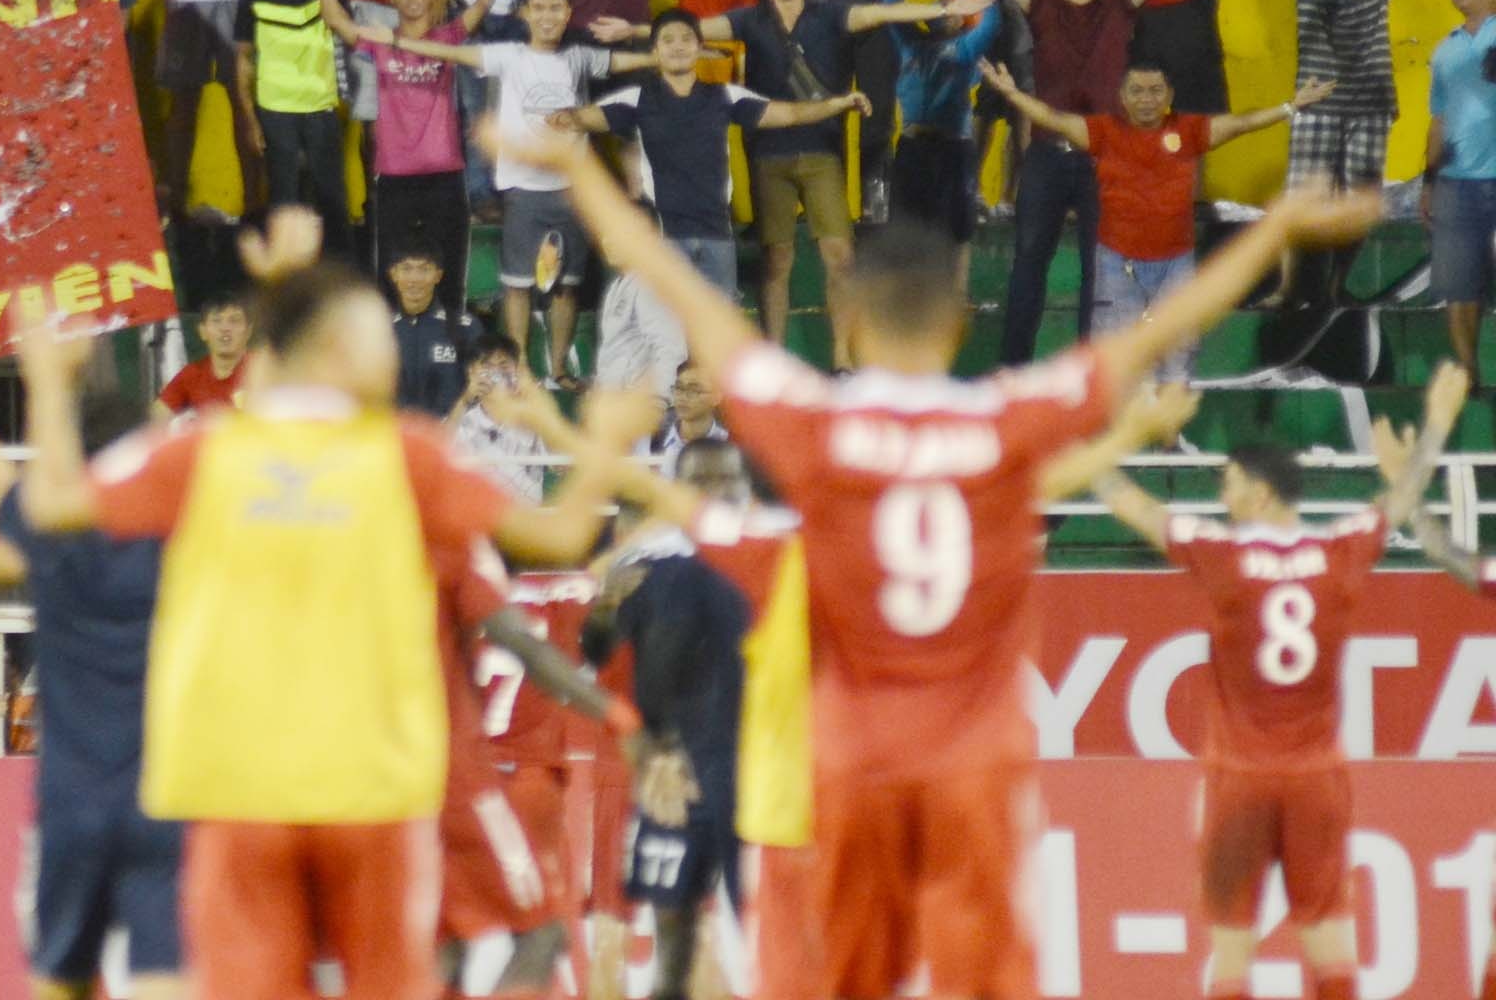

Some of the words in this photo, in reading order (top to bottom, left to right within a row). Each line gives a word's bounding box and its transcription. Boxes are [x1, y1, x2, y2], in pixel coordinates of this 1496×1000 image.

[873, 480, 973, 638] 9
[1258, 583, 1317, 686] 8
[640, 836, 688, 889] 77
